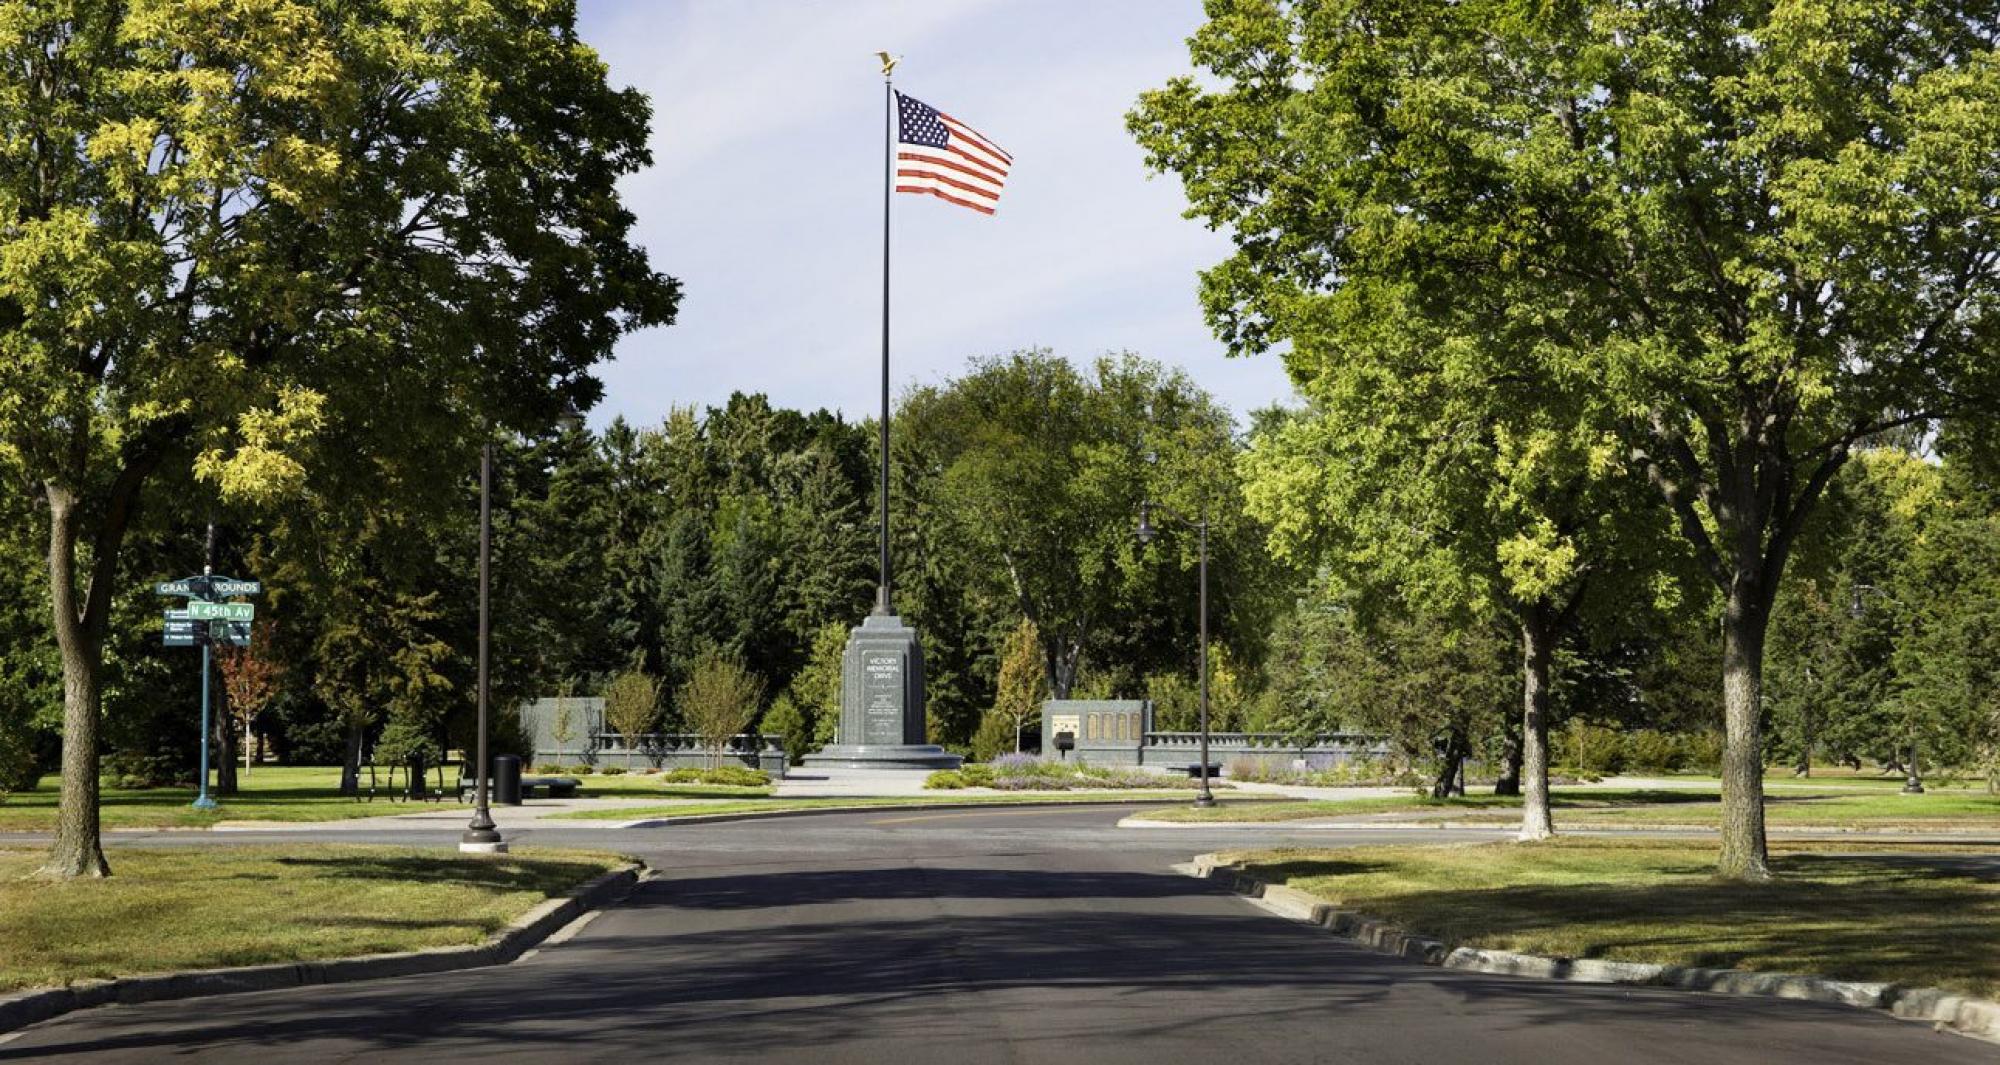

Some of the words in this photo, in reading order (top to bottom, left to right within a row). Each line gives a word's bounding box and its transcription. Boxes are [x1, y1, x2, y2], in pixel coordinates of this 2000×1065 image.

[160, 583, 190, 592] GRAN
[214, 583, 258, 592] ROUNDS
[191, 604, 199, 617] N
[203, 605, 232, 617] 45th
[235, 607, 250, 617] Av
[870, 657, 897, 665] VICTORY
